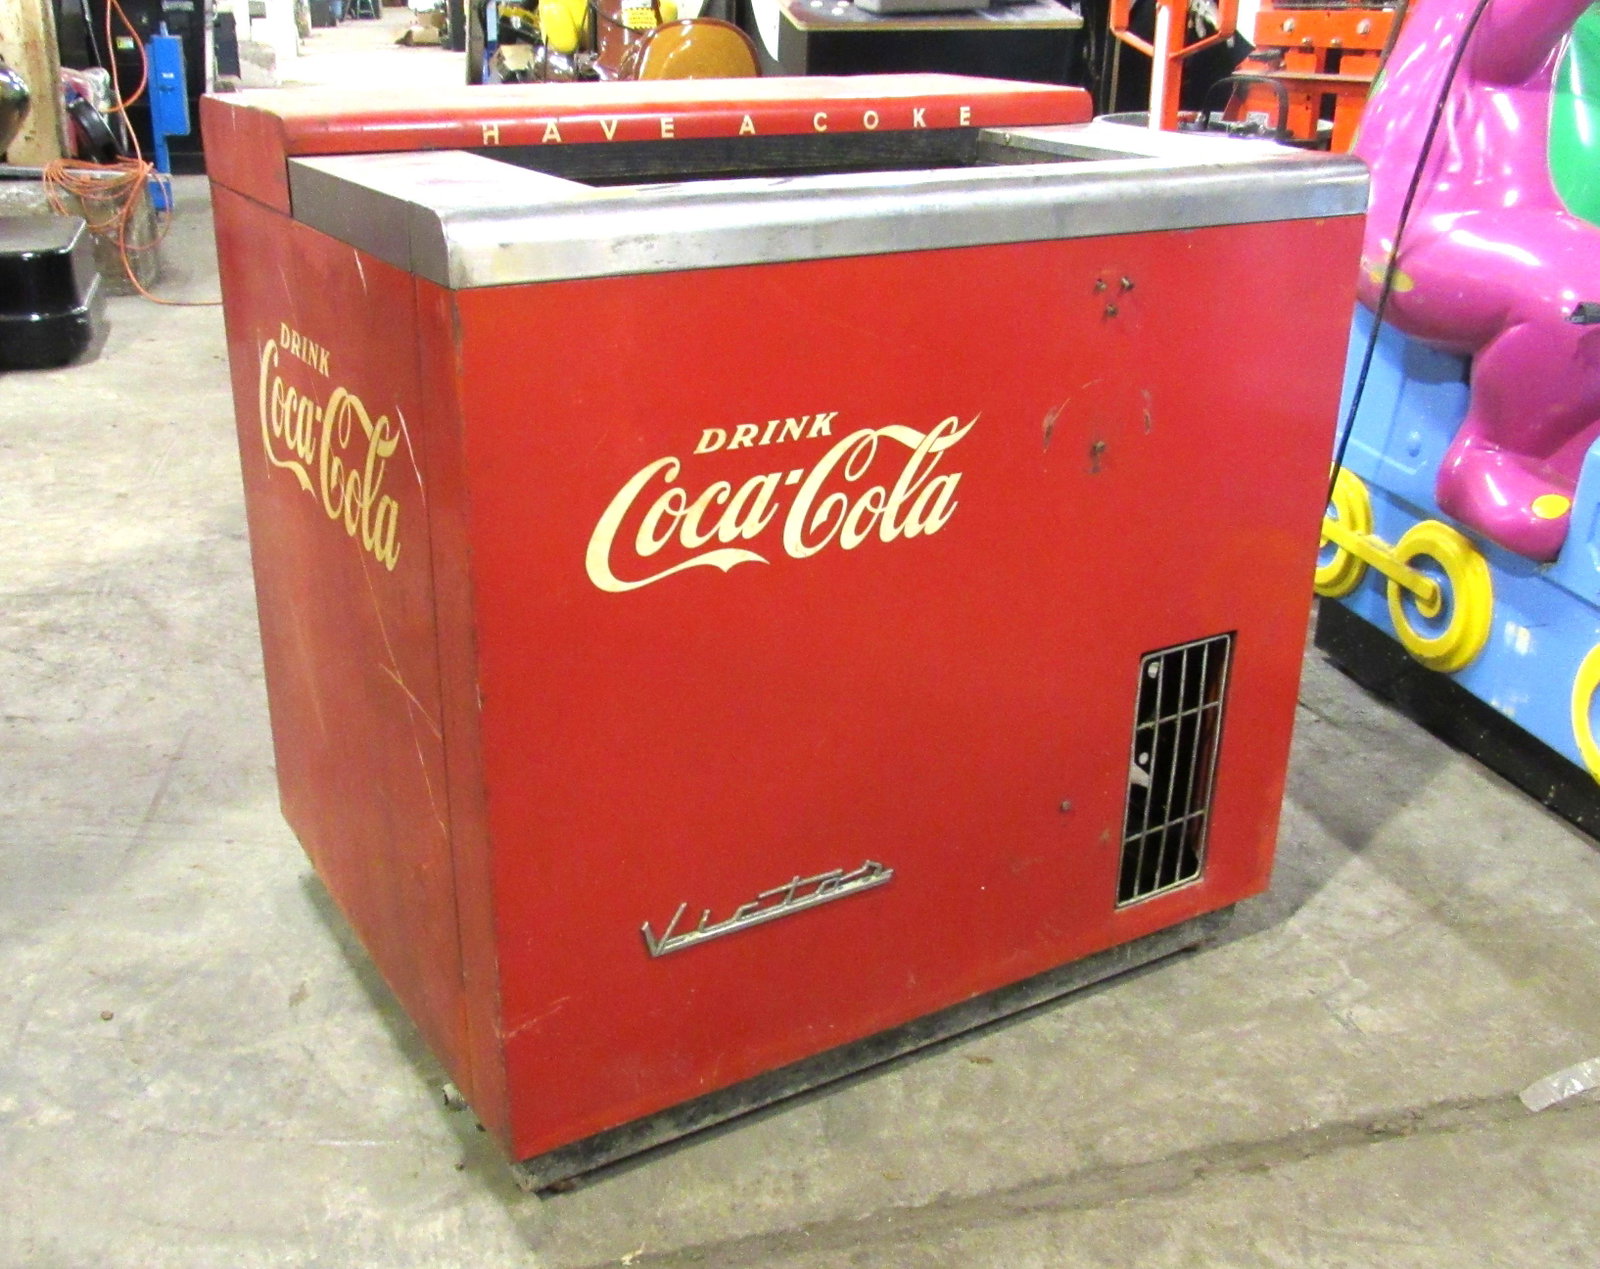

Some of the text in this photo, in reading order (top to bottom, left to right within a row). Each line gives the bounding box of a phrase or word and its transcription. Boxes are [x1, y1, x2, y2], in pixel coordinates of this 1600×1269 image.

[481, 105, 972, 145] HAVE A COKE
[279, 322, 330, 377] DRINK
[259, 339, 400, 571] Coca-Cola
[693, 411, 838, 454] DRINK
[585, 411, 982, 593] Coca-Cola
